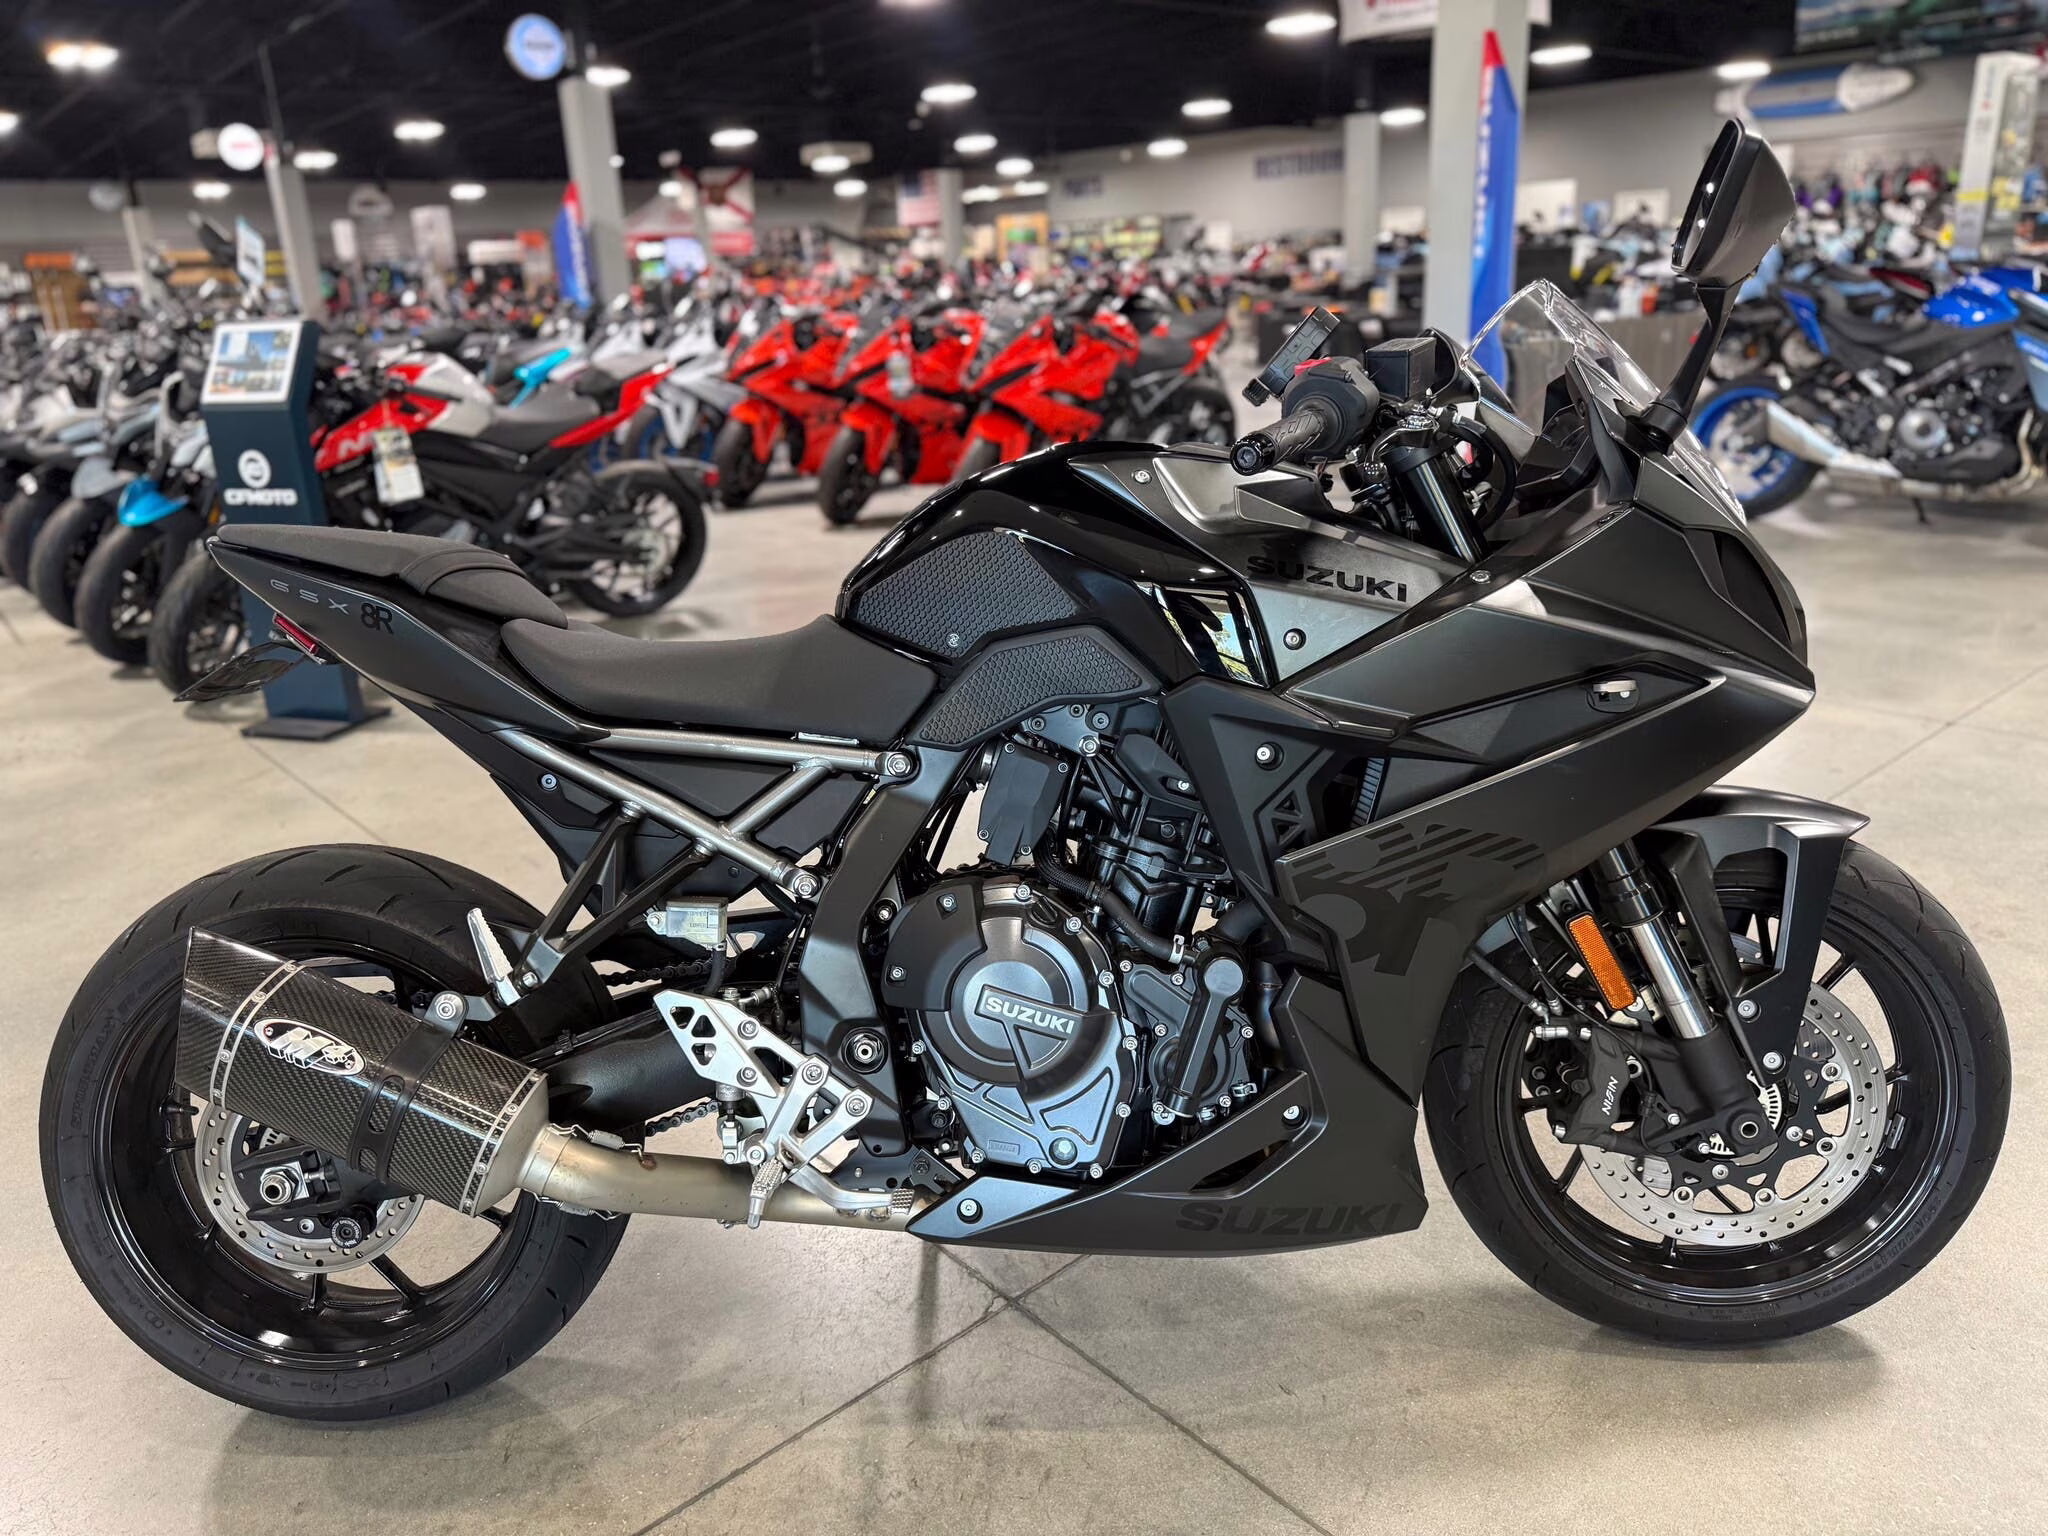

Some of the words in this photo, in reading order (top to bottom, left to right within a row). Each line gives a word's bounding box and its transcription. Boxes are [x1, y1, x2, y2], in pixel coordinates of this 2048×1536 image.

[1246, 555, 1407, 602] SUZUKI
[360, 602, 394, 634] 8R
[983, 996, 1075, 1035] SUZUKI
[1176, 1201, 1403, 1236] SUZUKI
